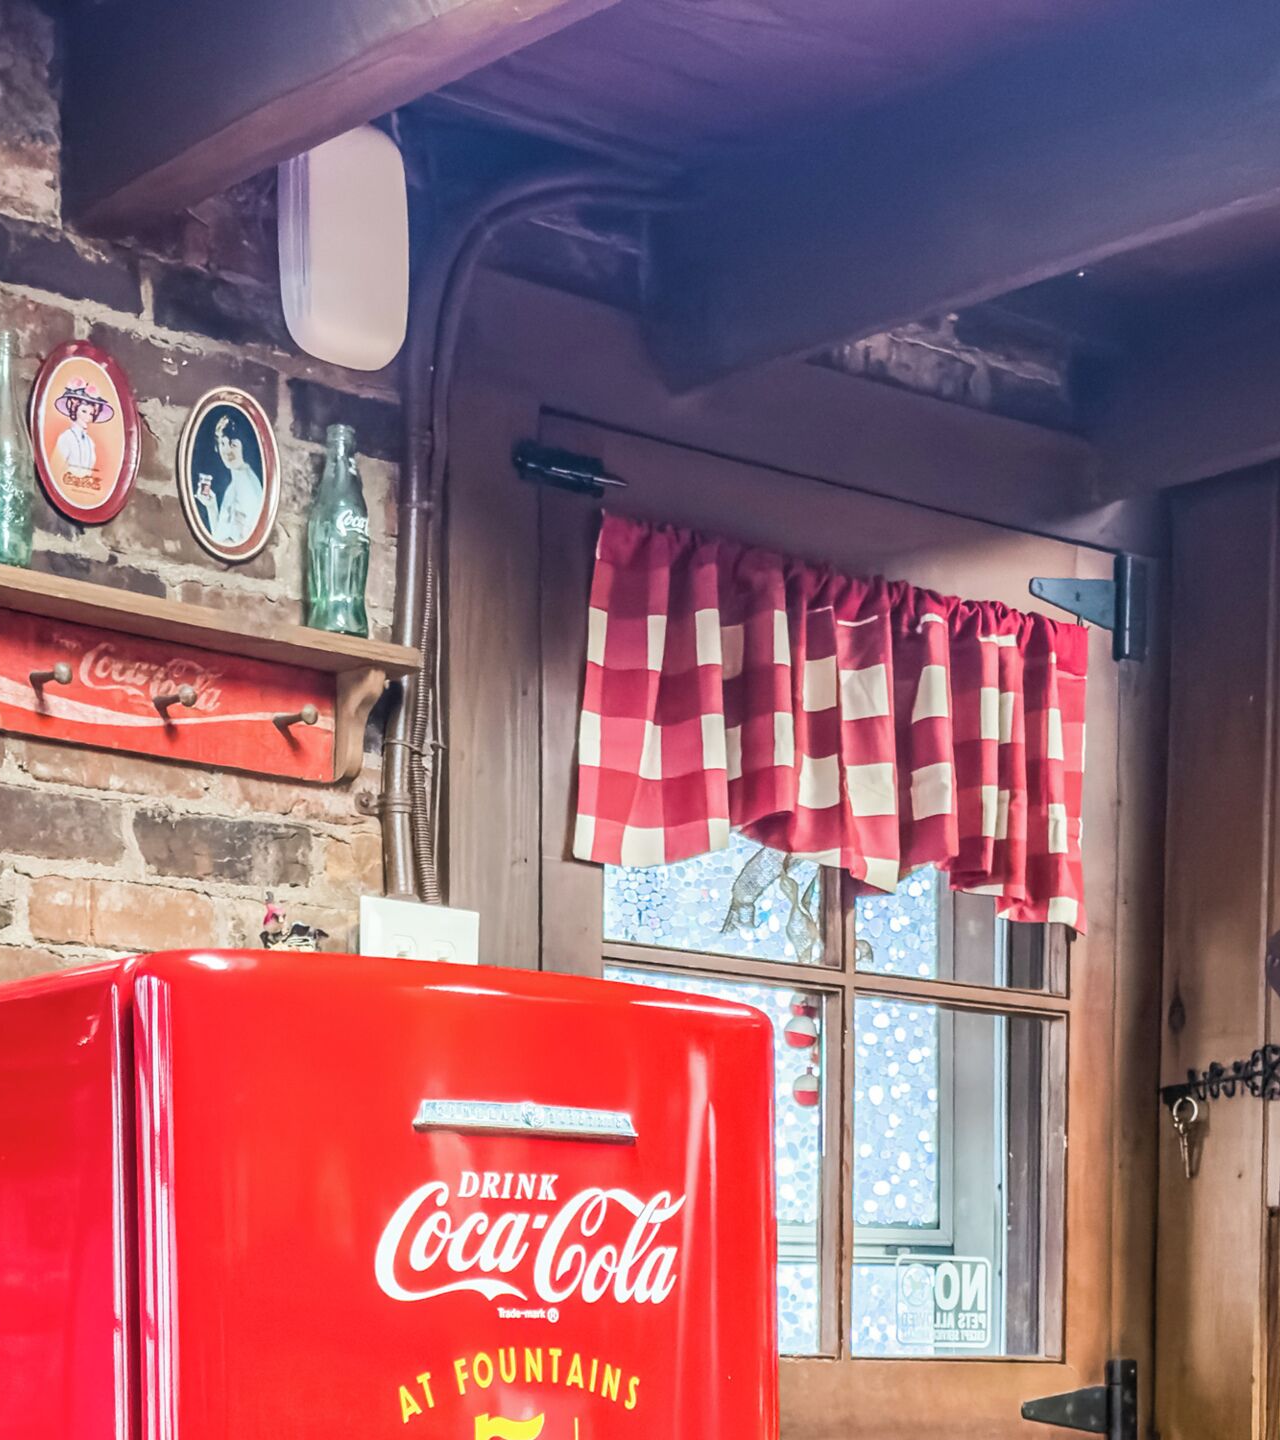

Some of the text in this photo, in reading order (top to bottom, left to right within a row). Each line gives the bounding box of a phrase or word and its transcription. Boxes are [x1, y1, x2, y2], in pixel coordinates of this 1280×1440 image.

[457, 1171, 559, 1201] DRINK
[373, 1181, 687, 1304] Coca-Cola
[399, 1346, 641, 1423] AT FOUNTAINS
